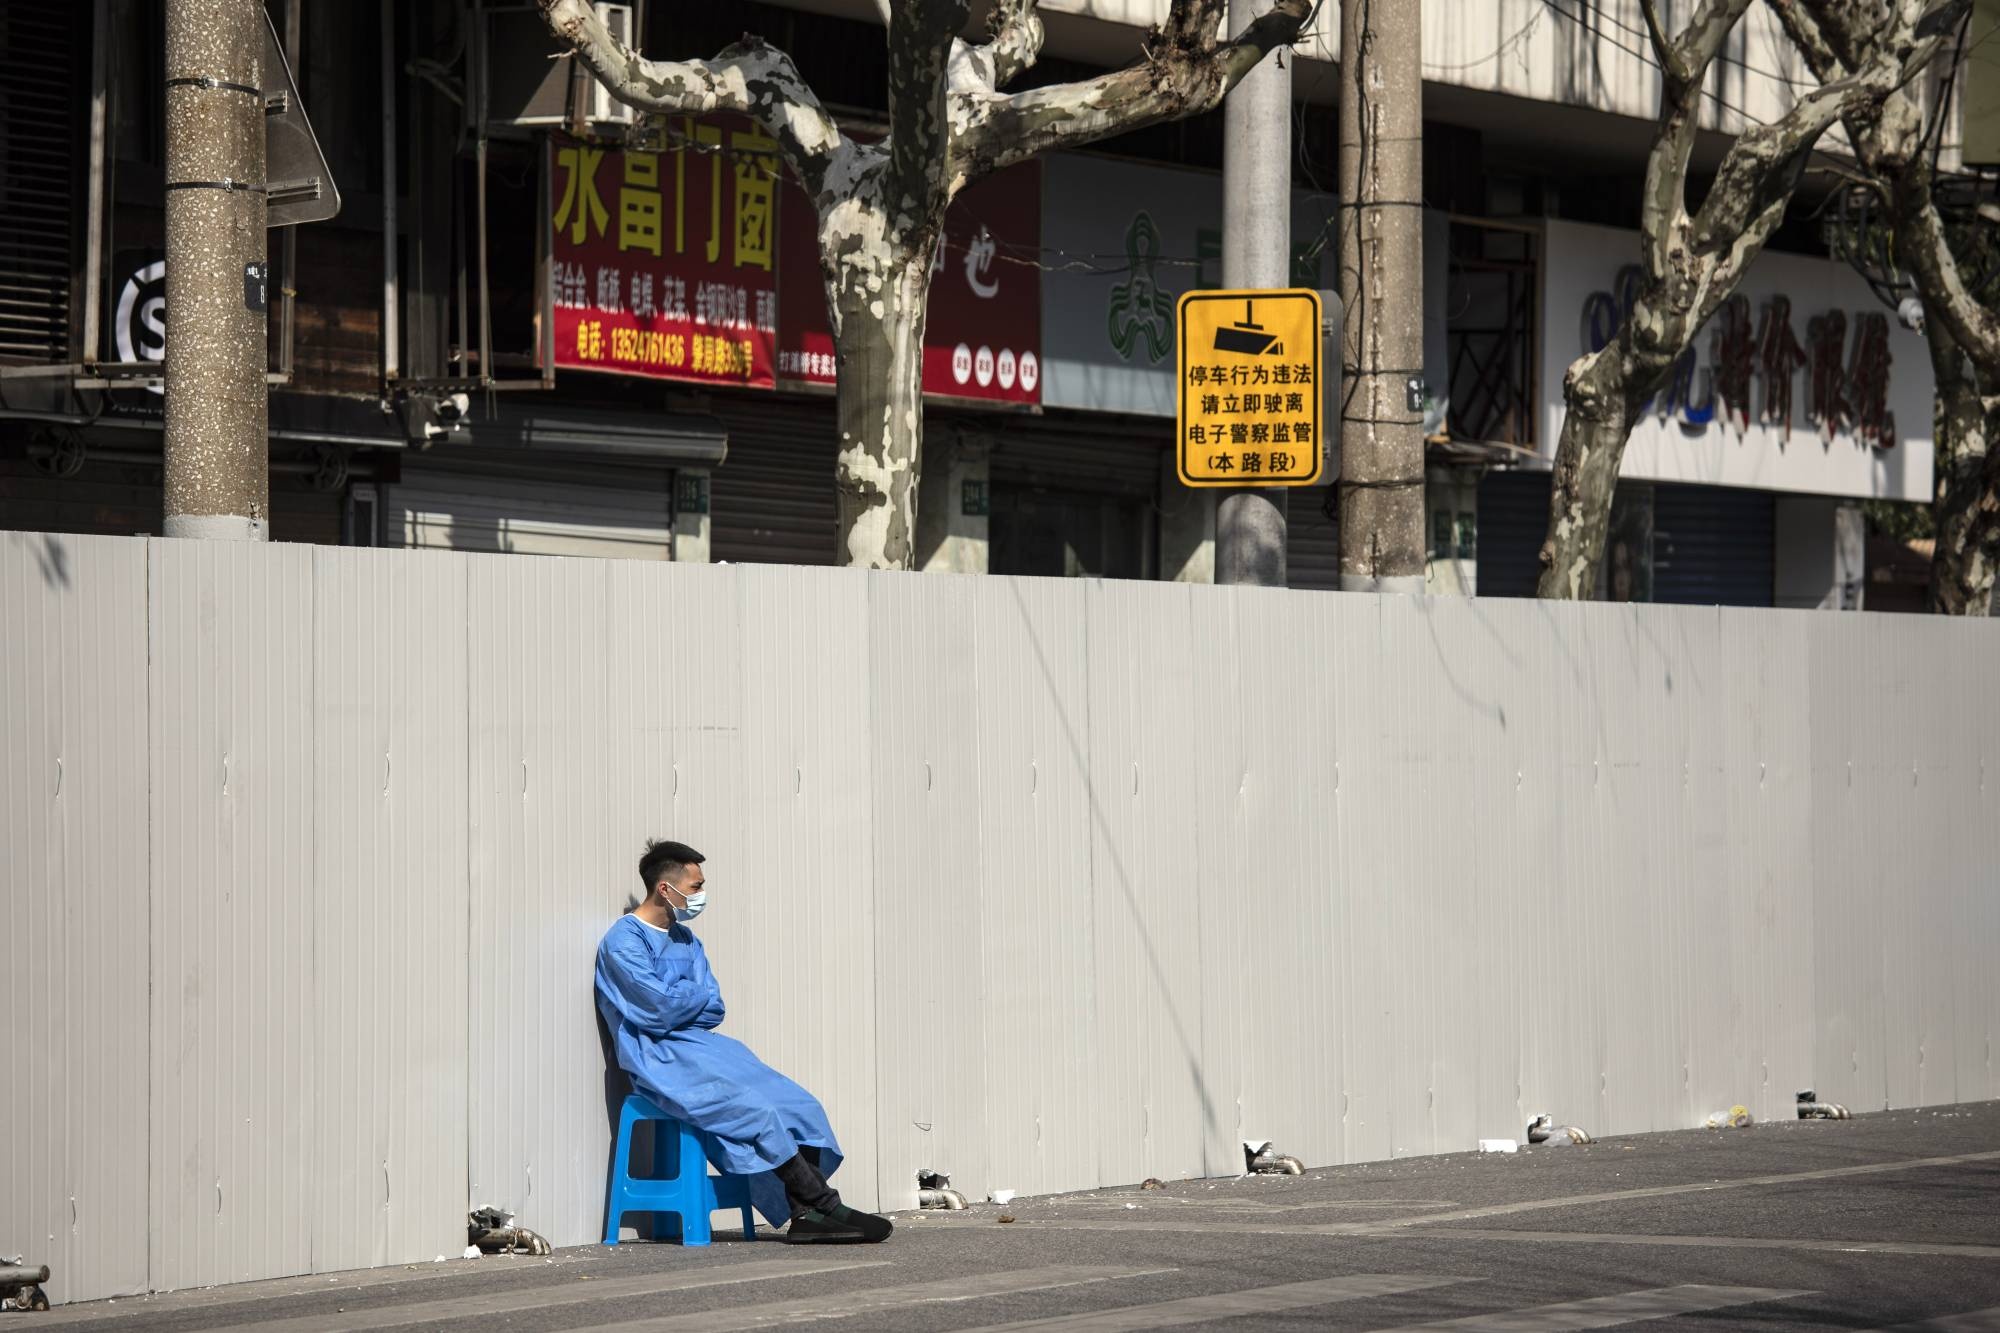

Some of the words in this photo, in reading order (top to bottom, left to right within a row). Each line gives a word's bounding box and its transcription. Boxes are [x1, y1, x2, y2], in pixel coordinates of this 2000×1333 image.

[611, 328, 685, 367] 13524761436
[1188, 363, 1312, 386] 停车行为违法
[1201, 393, 1303, 414] 请立即驶离
[1189, 422, 1312, 444] 电子警察监管
